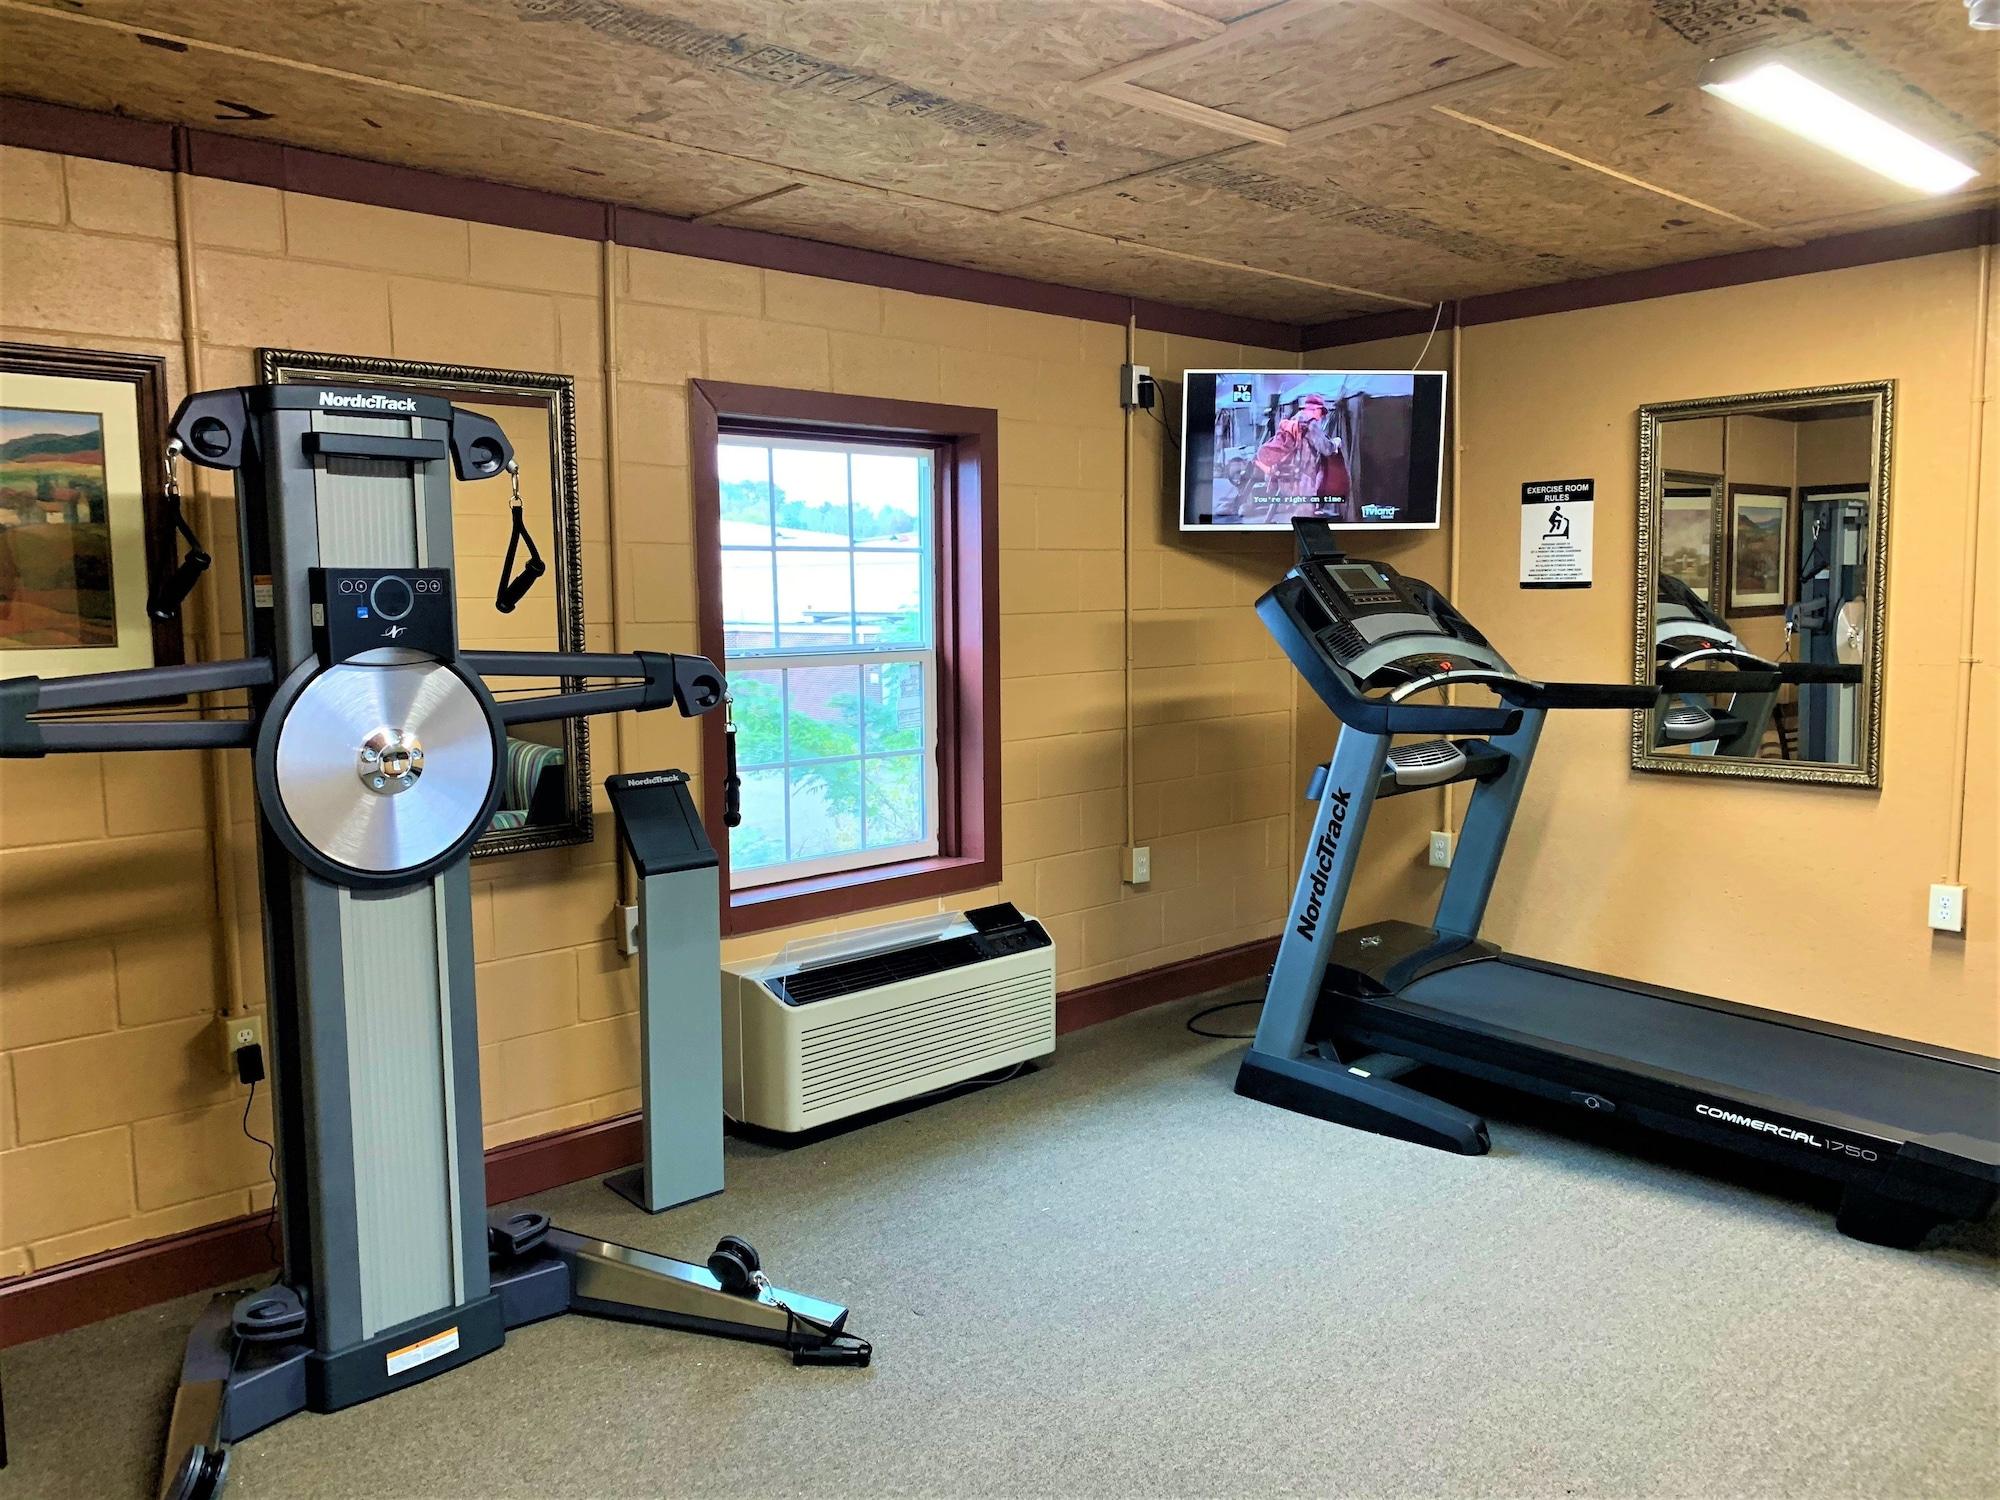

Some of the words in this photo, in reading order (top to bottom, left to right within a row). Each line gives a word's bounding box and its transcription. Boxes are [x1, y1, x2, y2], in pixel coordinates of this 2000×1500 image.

[319, 391, 416, 411] NordicTrack
[1233, 391, 1251, 402] PG
[1527, 485, 1564, 494] EXERCISE
[1565, 483, 1589, 492] ROOM
[1284, 496, 1307, 504] right
[1544, 493, 1570, 502] RULES
[627, 774, 679, 787] NordicTrack
[1296, 786, 1352, 942] NordicTrack
[1695, 1104, 1822, 1147] COMMERCIAL
[1824, 1138, 1878, 1162] 1750
